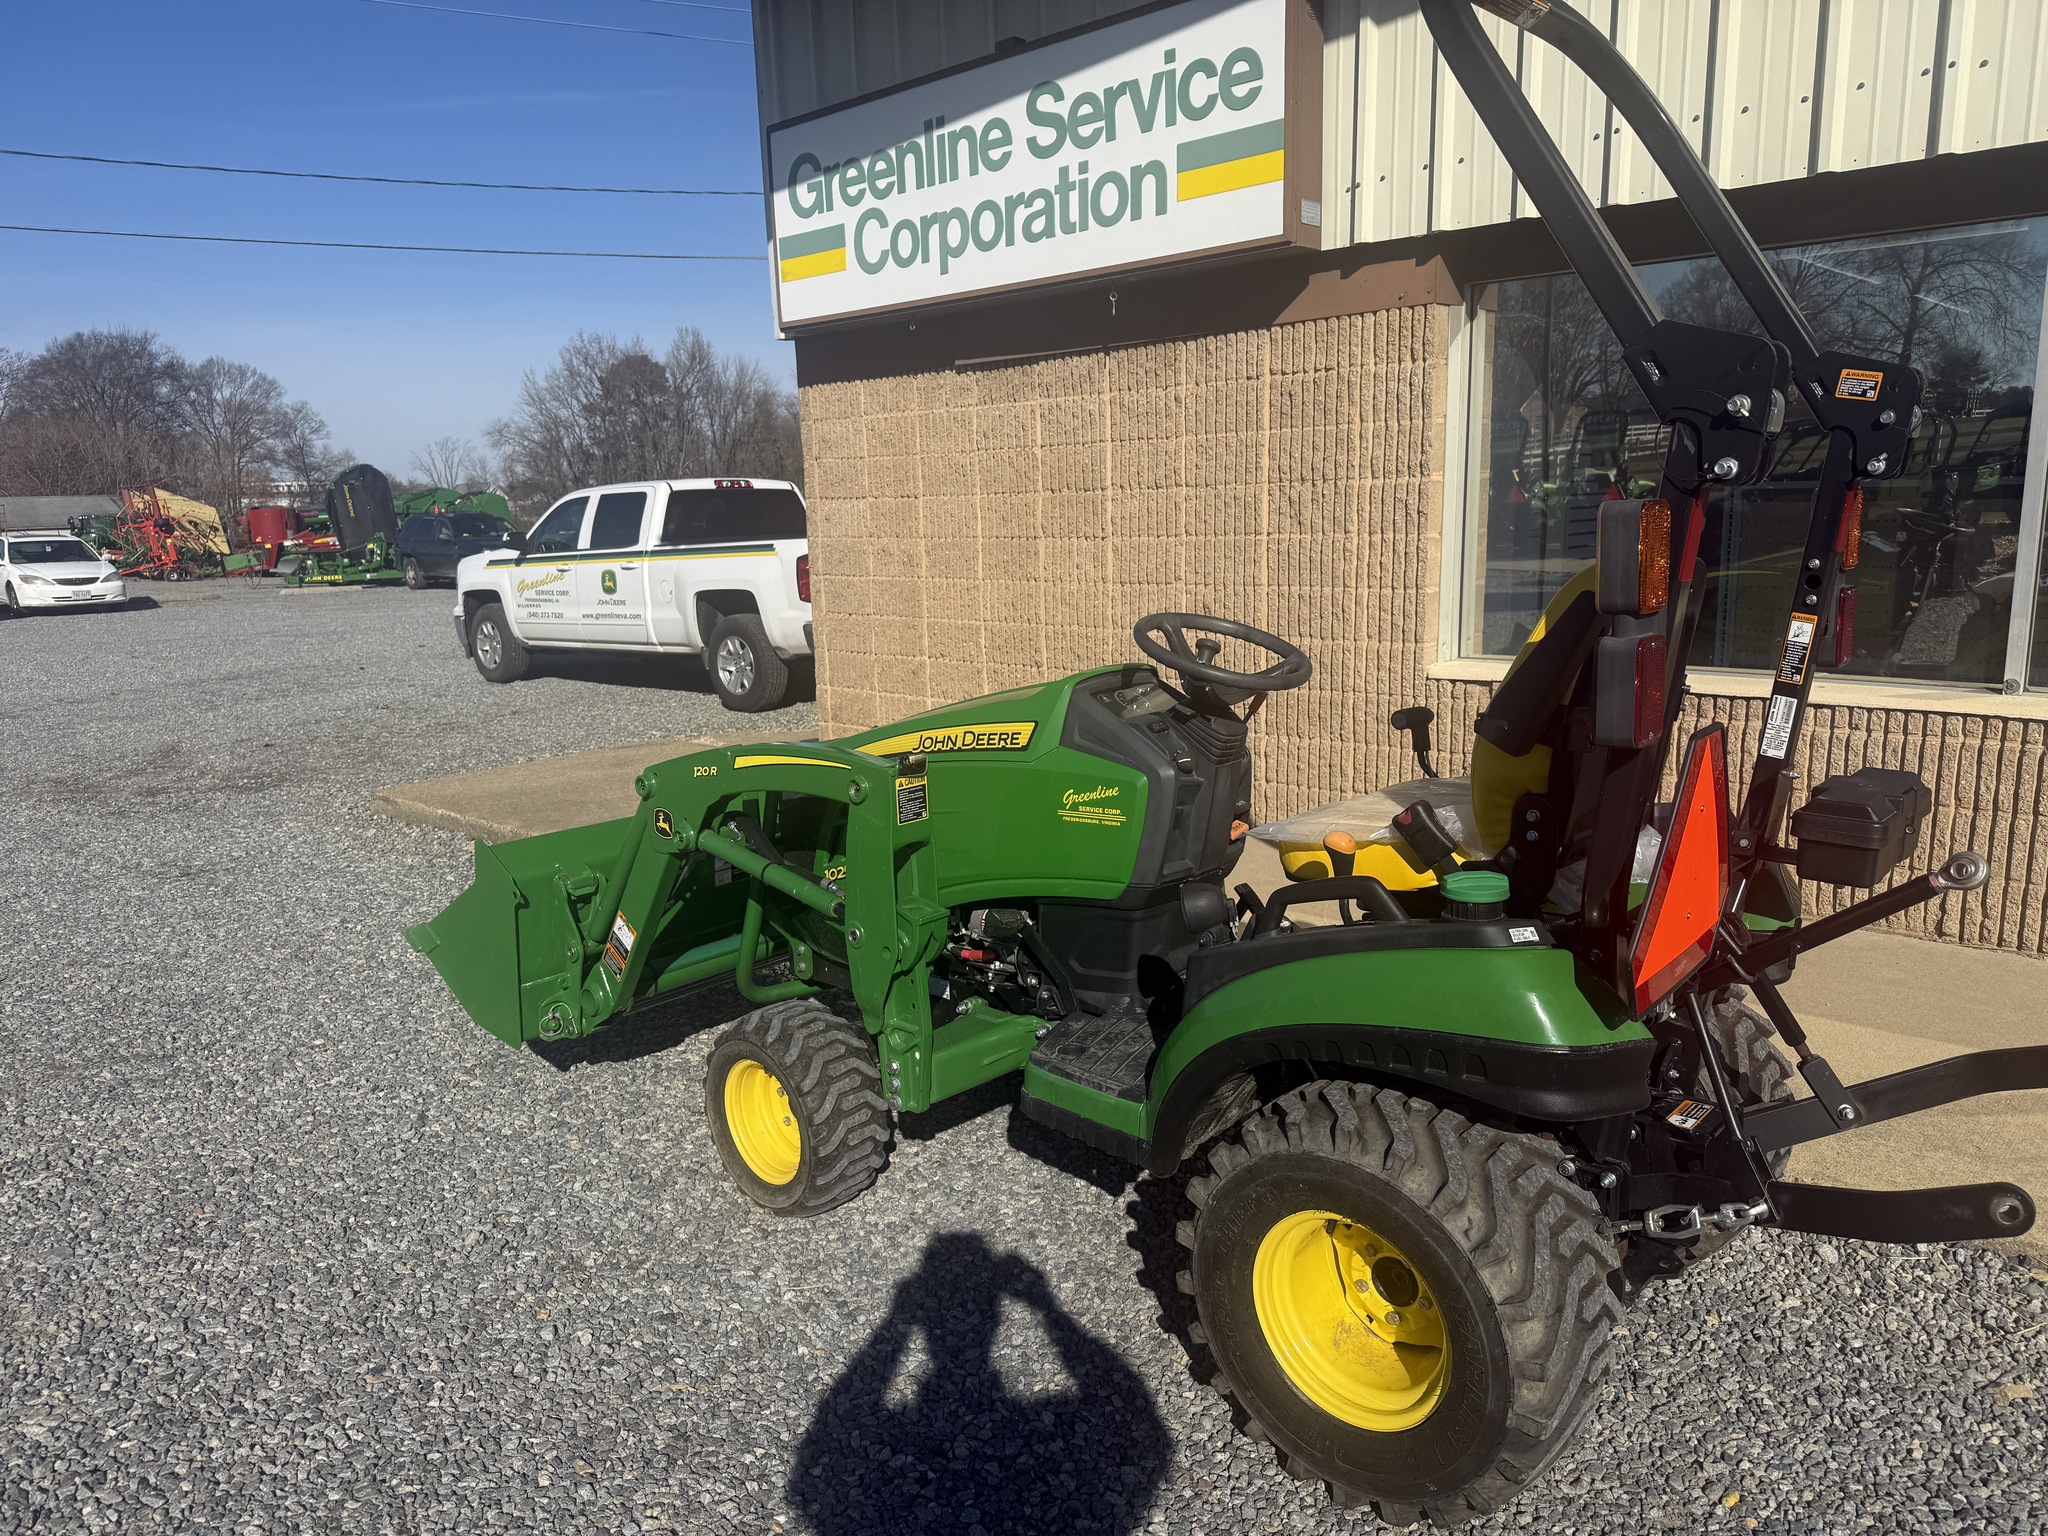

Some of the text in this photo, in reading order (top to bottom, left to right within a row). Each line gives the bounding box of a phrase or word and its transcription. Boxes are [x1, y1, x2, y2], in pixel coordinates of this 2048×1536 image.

[787, 46, 1264, 220] Greenline Service
[853, 159, 1168, 276] Corporation
[1851, 371, 1879, 379] WARNING
[517, 571, 565, 598] Greenline
[535, 589, 556, 597] SERVICE
[597, 598, 627, 606] JOHN DEERE
[527, 611, 564, 619] (540) 373-7520
[582, 611, 642, 620] www.greenlineva.com
[911, 731, 1022, 752] JOHN DEERE
[904, 776, 926, 787] CAUTION
[1063, 785, 1119, 809] Greenline
[1079, 805, 1103, 813] SERVICE
[1214, 1269, 1241, 1348] TRAC
